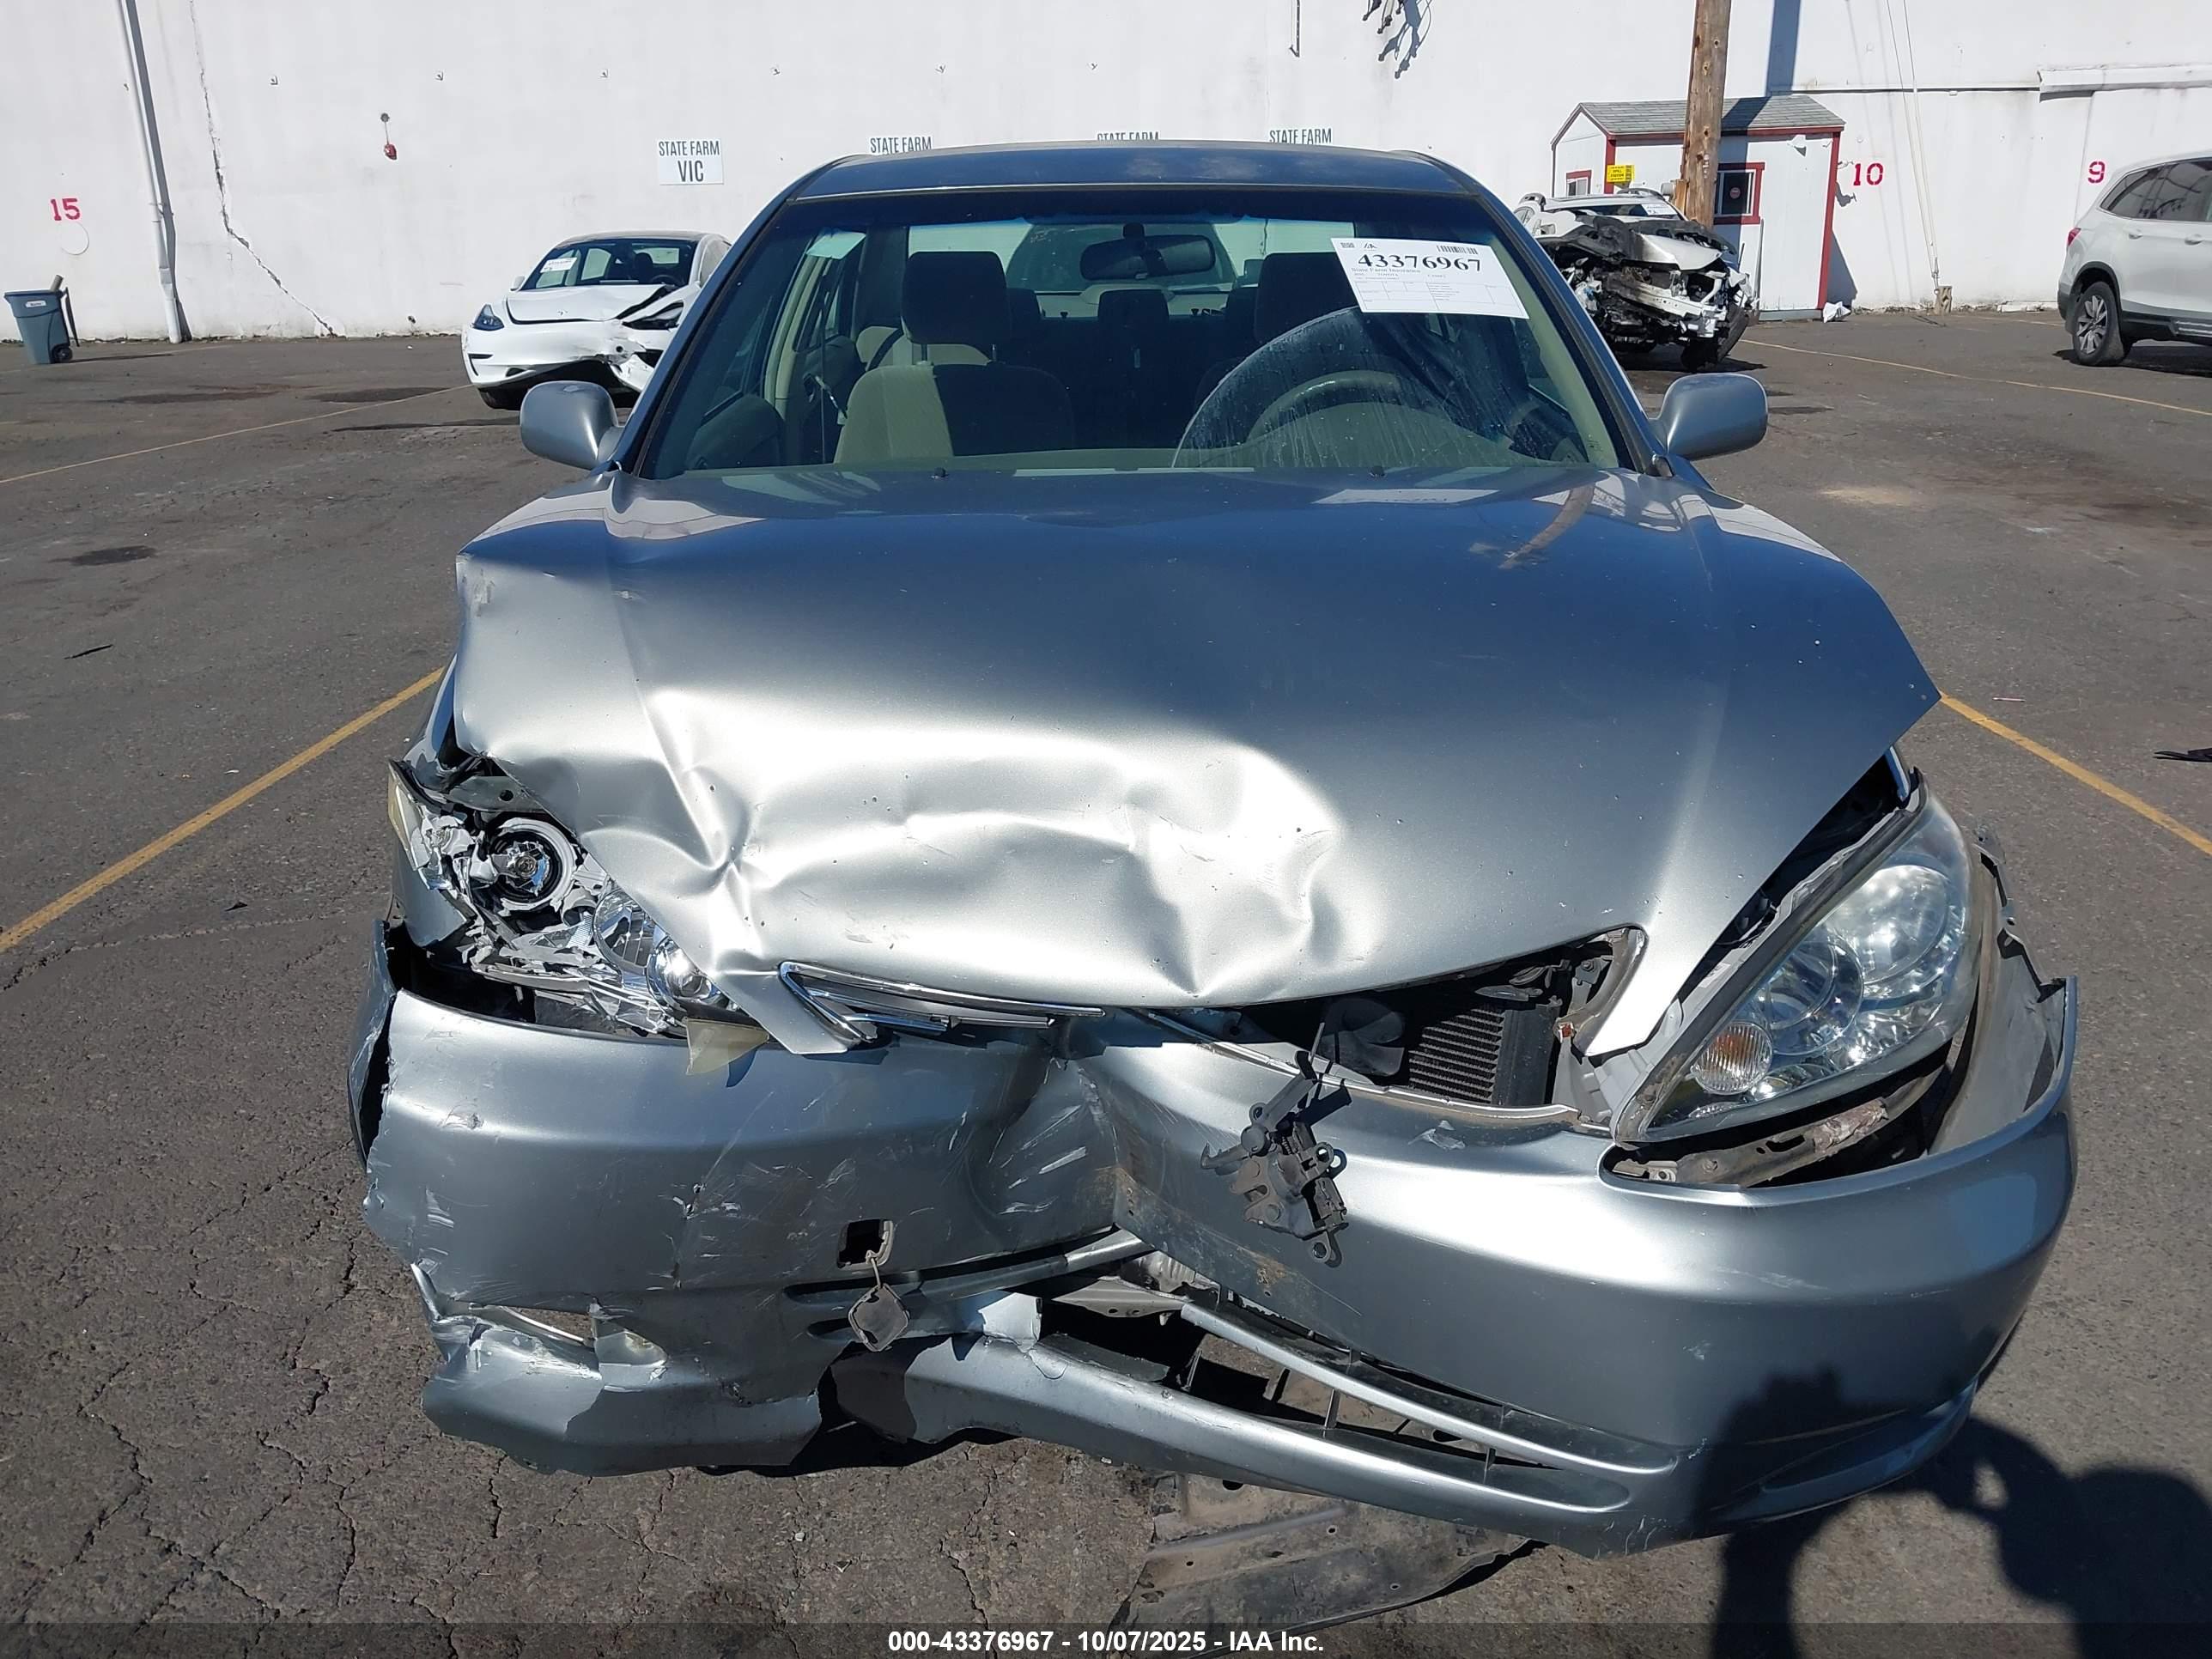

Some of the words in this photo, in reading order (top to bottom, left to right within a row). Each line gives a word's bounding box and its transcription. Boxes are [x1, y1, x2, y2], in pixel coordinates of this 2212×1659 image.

[870, 137, 899, 154] STATE
[902, 136, 932, 153] FARM
[1269, 129, 1298, 144] STATE
[1301, 128, 1332, 144] FARM
[659, 141, 687, 156] STATE
[690, 140, 720, 155] FARM
[678, 160, 704, 182] VIC
[1853, 162, 1884, 186] 10
[2087, 161, 2106, 184] 9
[51, 198, 81, 221] 15
[1358, 253, 1480, 272] 43376967
